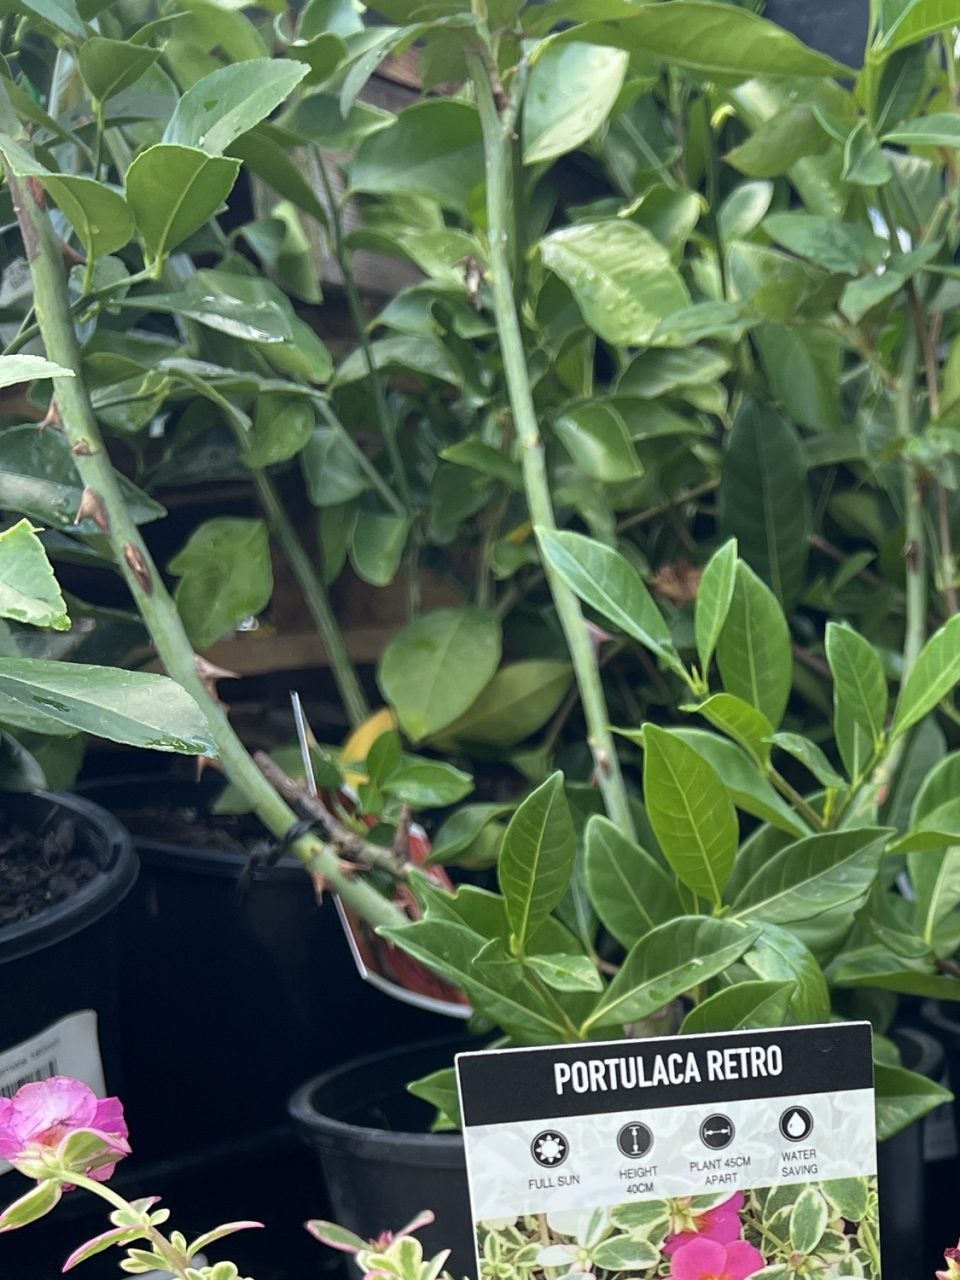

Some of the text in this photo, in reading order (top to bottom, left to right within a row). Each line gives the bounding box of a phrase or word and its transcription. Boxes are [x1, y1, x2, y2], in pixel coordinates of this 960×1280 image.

[554, 1044, 783, 1095] PORTULACA RETRO
[781, 1149, 817, 1162] WATER
[690, 1156, 751, 1172] PLANT 45CM
[781, 1163, 818, 1177] SAVING
[619, 1166, 658, 1180] HEIGHT
[704, 1172, 738, 1186] APART
[528, 1174, 581, 1191] FULL SUN
[626, 1181, 654, 1194] 40CM
